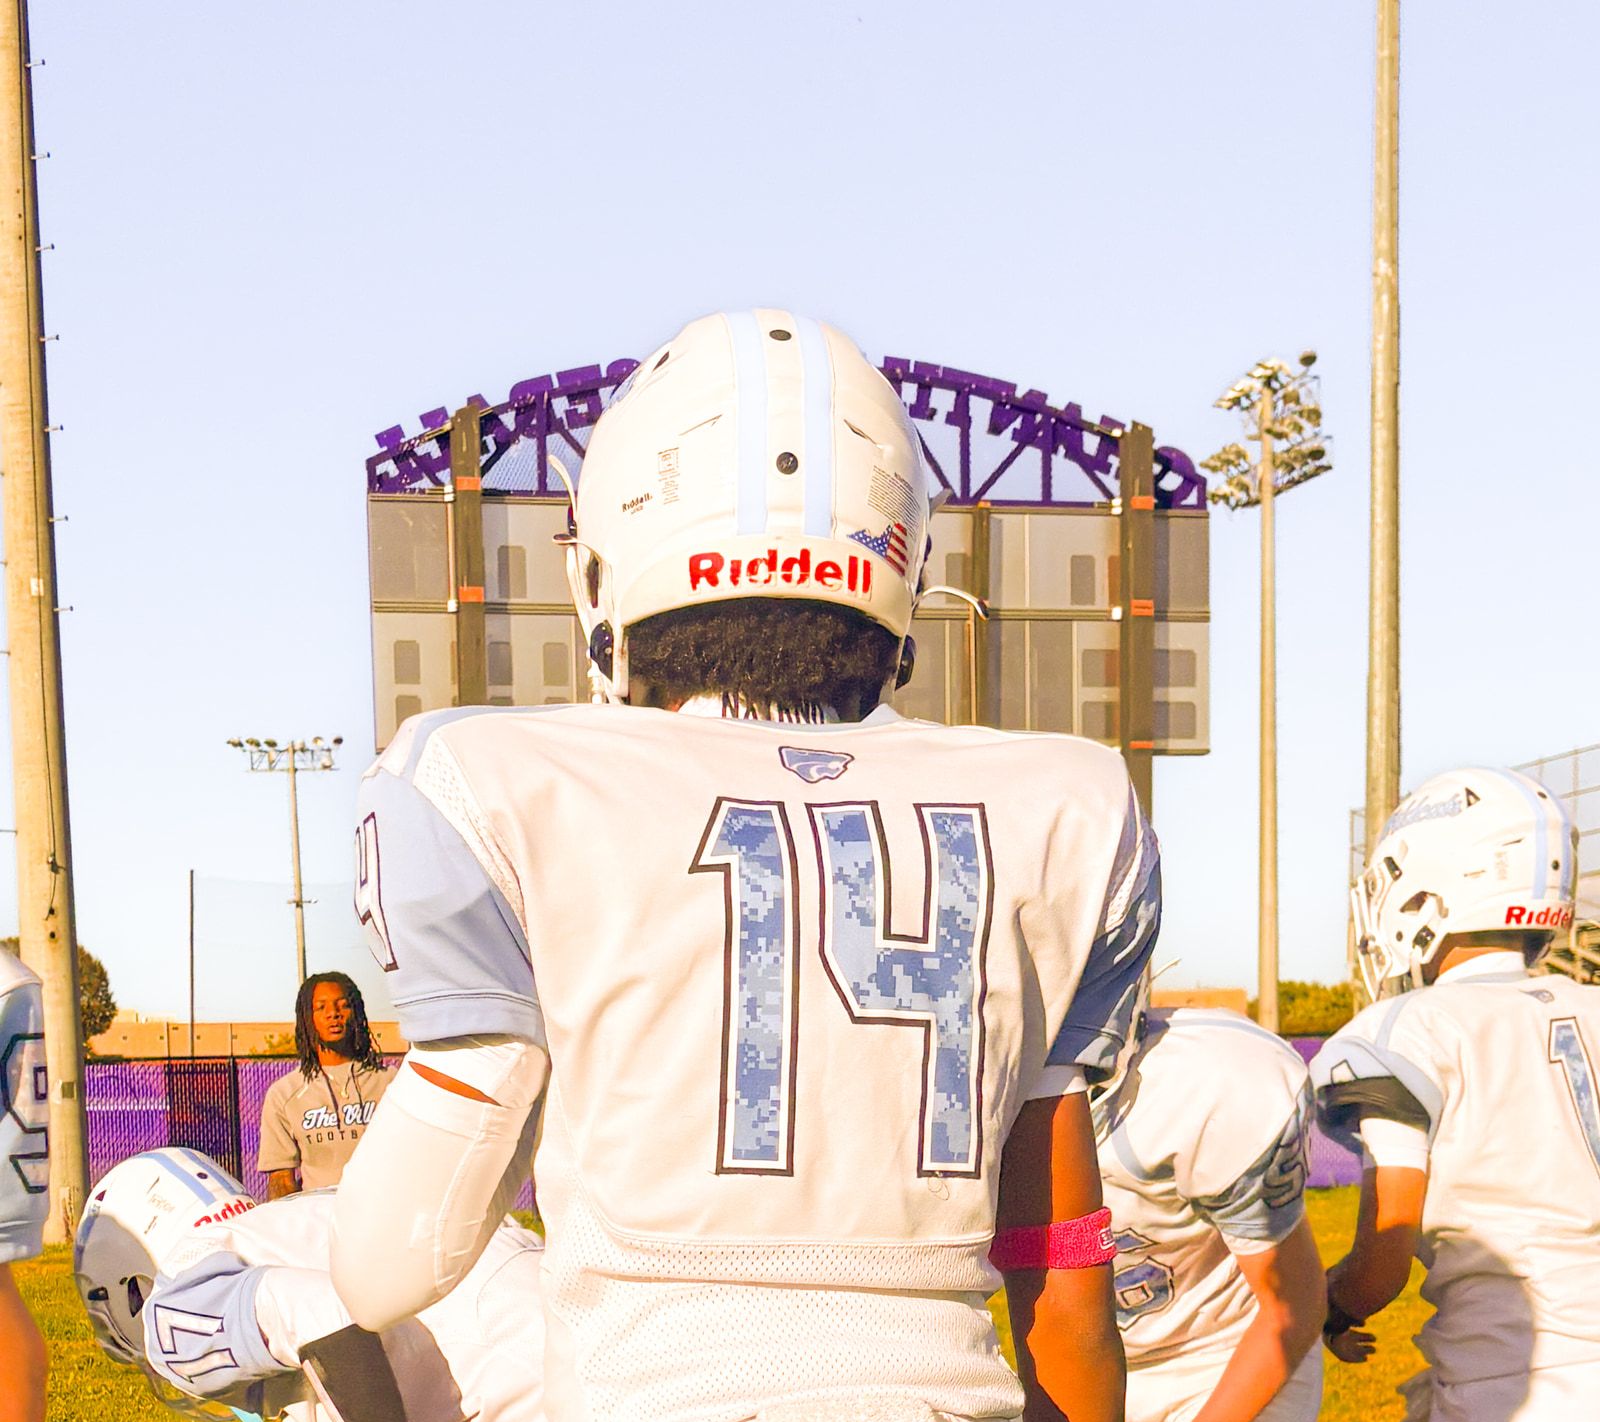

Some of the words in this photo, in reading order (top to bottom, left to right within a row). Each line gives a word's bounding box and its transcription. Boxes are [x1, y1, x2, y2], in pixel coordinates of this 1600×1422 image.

[688, 547, 873, 598] Riddell
[688, 796, 994, 1178] 14
[303, 1105, 338, 1130] The
